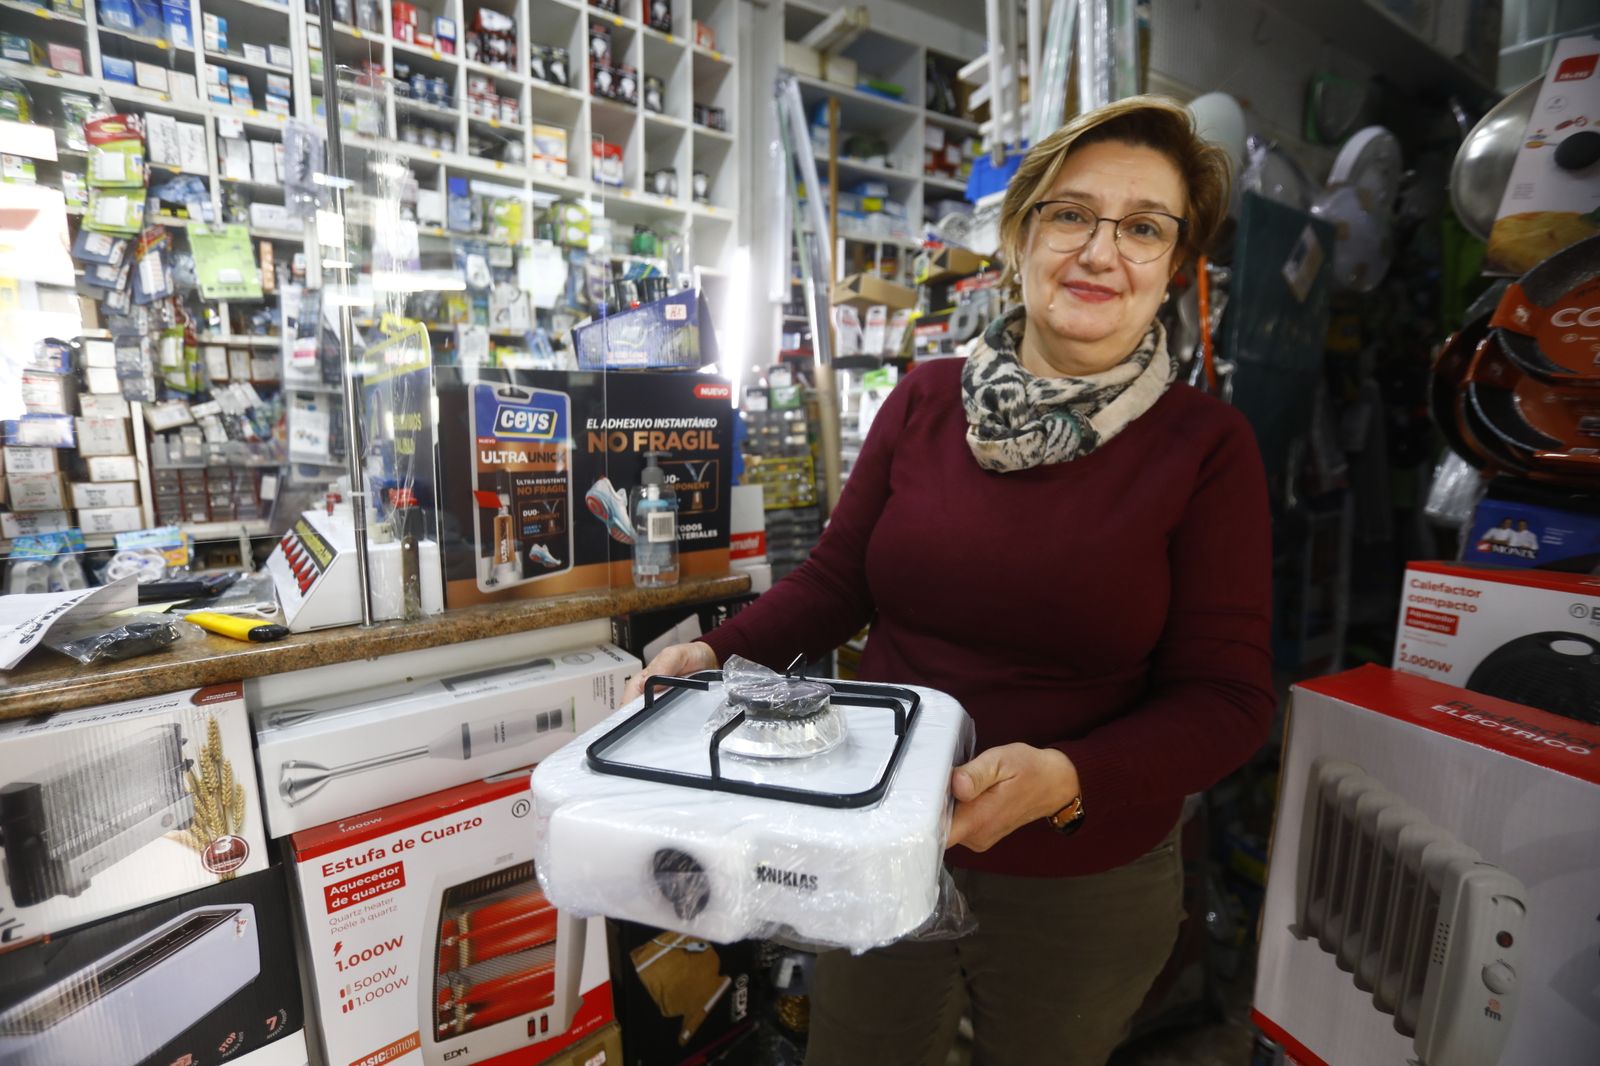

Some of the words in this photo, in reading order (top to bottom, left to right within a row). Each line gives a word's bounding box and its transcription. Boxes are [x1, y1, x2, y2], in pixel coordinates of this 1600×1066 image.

[700, 387, 729, 396] NUEVO
[500, 410, 549, 433] ceys
[586, 418, 599, 429] EL
[600, 418, 653, 429] ADHESIVO
[653, 416, 718, 429] INSTANTÁNEO
[587, 431, 628, 454] NO
[633, 430, 720, 453] FRAGIL
[517, 487, 533, 496] NO
[534, 484, 567, 495] FRAGIL
[536, 477, 567, 485] RESISTENTE
[1410, 579, 1483, 598] Calefactor
[1408, 594, 1478, 613] compacto
[1400, 652, 1453, 673] 2.000W
[1431, 704, 1591, 755] ELECTRICO
[321, 847, 386, 878] Estufa
[391, 838, 416, 854] de
[420, 817, 483, 844] Cuarzo
[329, 865, 400, 897] Aquecedor
[331, 895, 349, 909] de
[352, 878, 401, 905] quartzo
[328, 908, 362, 926] Quartz
[363, 896, 395, 914] heater
[367, 904, 398, 922] quartz
[335, 935, 404, 973] 1.000W
[353, 965, 398, 992] 500W
[355, 975, 410, 1007] 1.000W
[265, 1015, 278, 1031] 7
[218, 1031, 237, 1053] STOP
[443, 1046, 469, 1062] EDM
